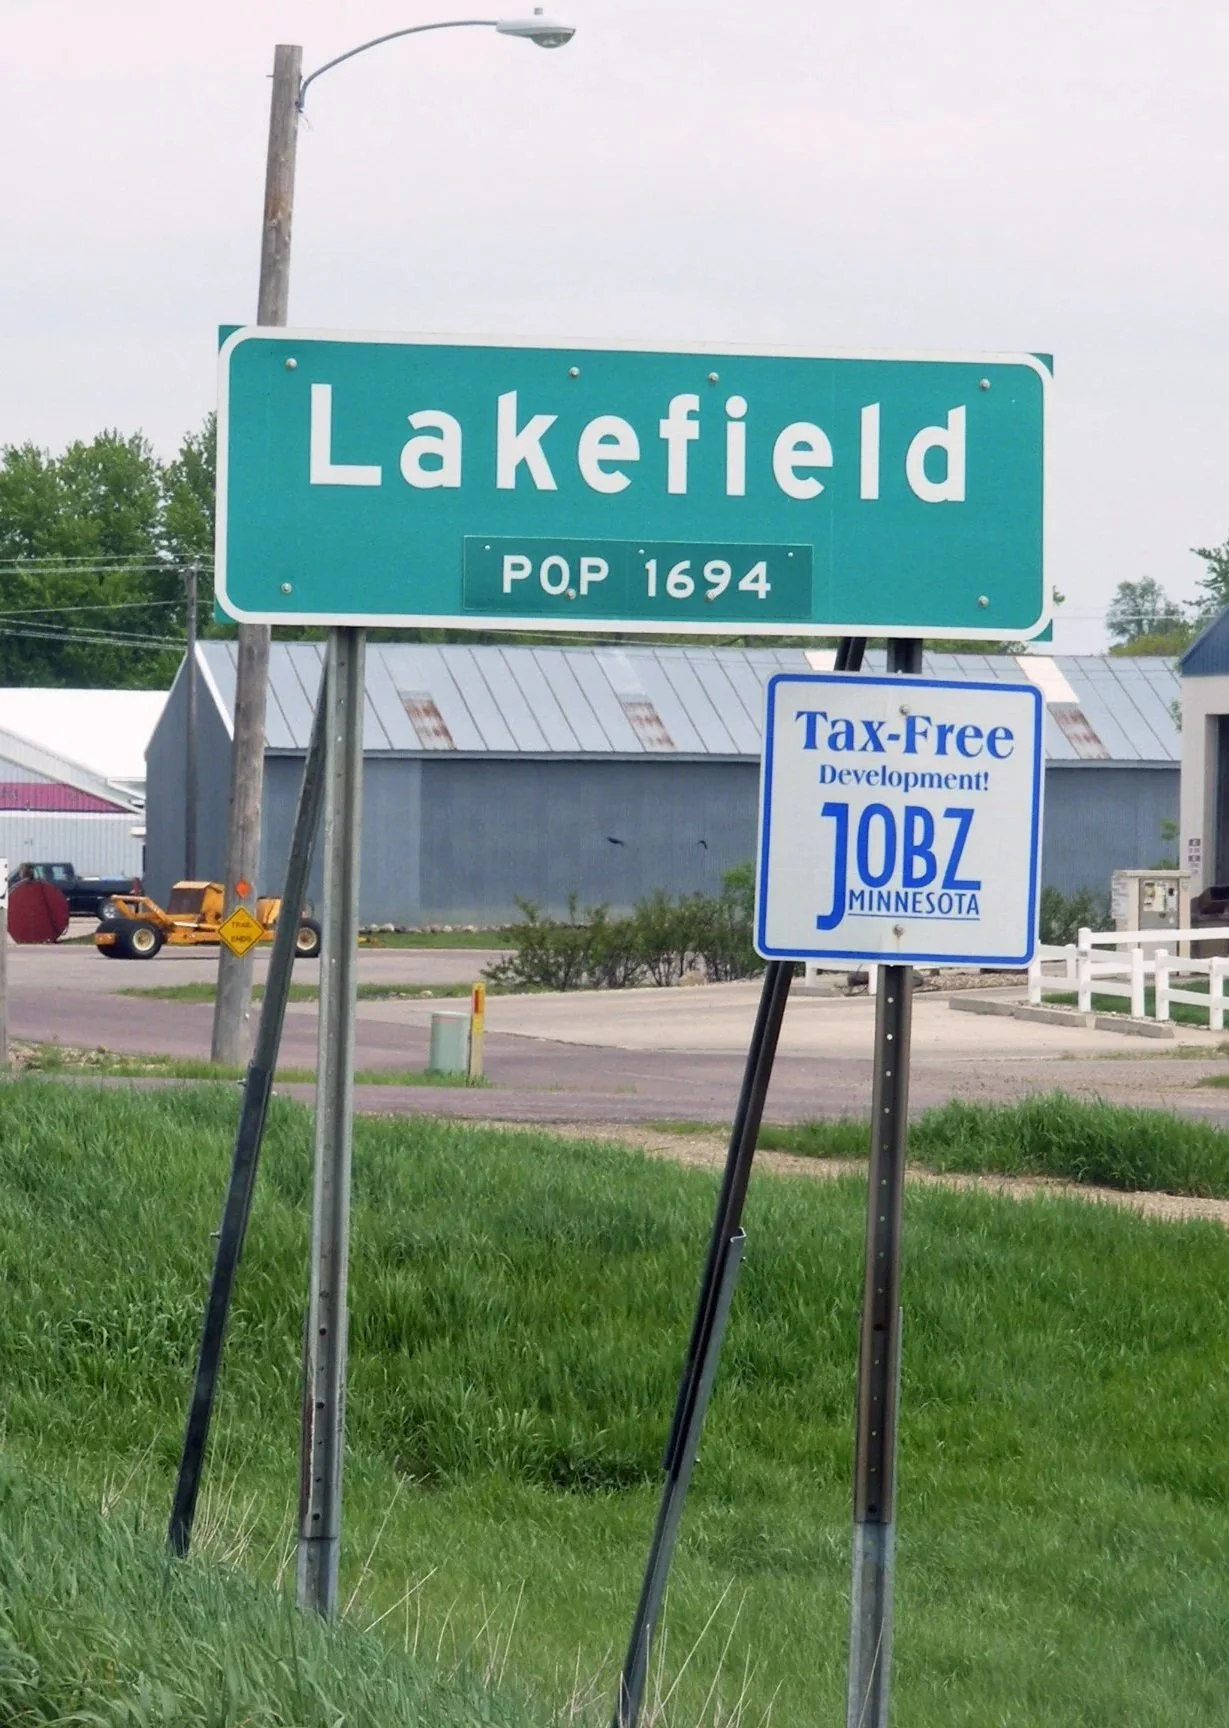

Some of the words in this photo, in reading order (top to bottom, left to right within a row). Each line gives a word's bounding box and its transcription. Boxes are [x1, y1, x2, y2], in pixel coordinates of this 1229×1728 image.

[310, 384, 966, 503] Lakefield
[502, 554, 609, 596] POP
[644, 559, 771, 600] 1694
[795, 710, 1014, 759] Tax-Free
[819, 764, 989, 792] Development!
[816, 802, 982, 931] JOBZ
[848, 890, 980, 916] MINNESOTA
